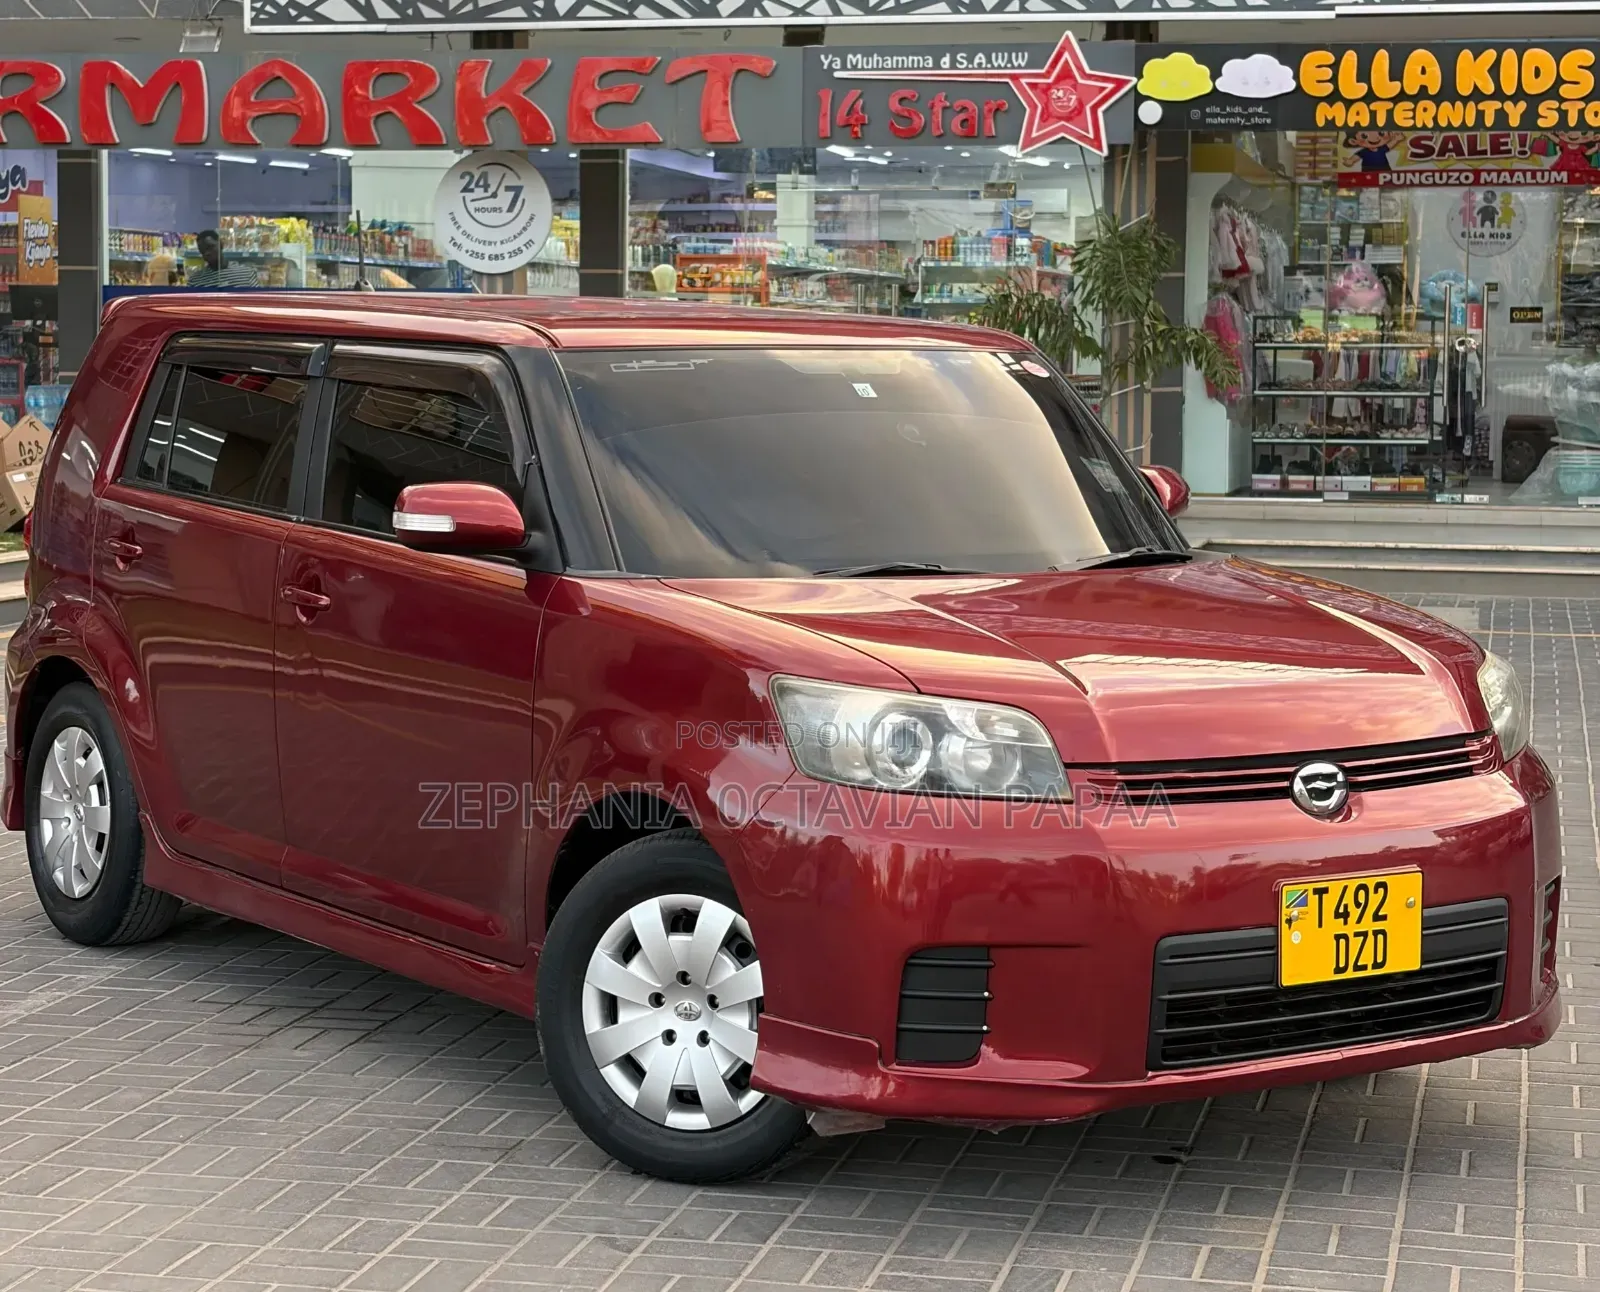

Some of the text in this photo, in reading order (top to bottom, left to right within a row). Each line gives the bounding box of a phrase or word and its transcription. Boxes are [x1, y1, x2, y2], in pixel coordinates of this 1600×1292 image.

[820, 54, 841, 70] Ya
[1300, 47, 1596, 99] ELLA KIDS
[816, 88, 1008, 138] 14 Star
[1205, 116, 1272, 126] maternity_store
[1316, 100, 1527, 128] MATERNITY
[1408, 131, 1531, 160] SALE!
[460, 171, 524, 213] 24 7
[1378, 170, 1568, 186] PUNGUZO MAALUM
[448, 211, 536, 247] FREE DELIVERY KIGAMBONI
[1461, 230, 1512, 240] ELLA KIDS
[448, 236, 463, 252] Tel:
[465, 248, 485, 261] +255
[488, 252, 505, 261] 685
[508, 246, 524, 259] 255
[1512, 311, 1541, 320] OPEN
[1333, 928, 1388, 975] DZD
